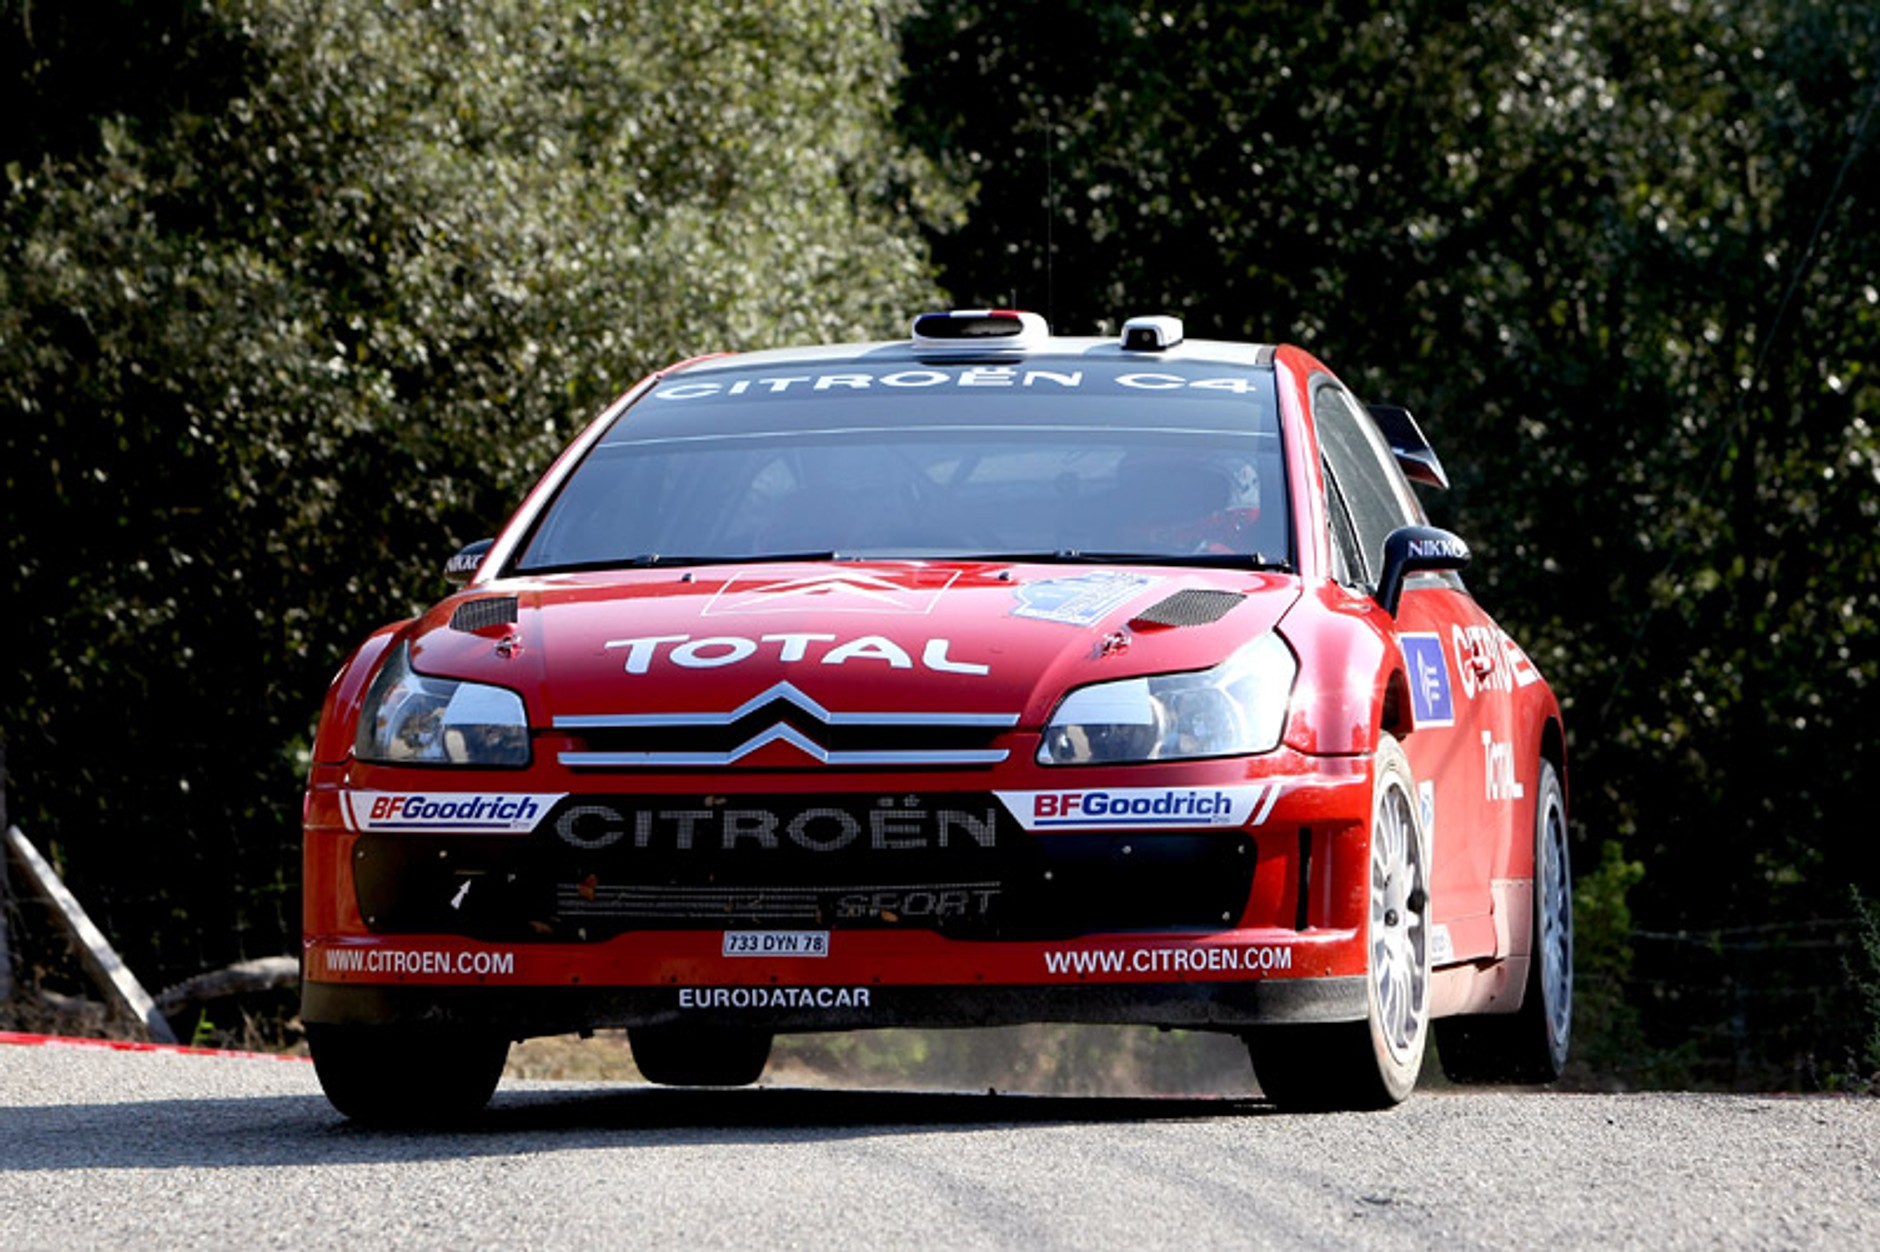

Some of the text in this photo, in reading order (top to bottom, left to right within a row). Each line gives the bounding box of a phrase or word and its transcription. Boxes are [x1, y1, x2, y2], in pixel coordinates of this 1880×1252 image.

[655, 366, 1257, 400] CITROËN C4
[604, 634, 989, 675] TOTAL
[370, 796, 539, 820] BFGoodrich
[1033, 791, 1232, 817] BFGoodrich
[554, 794, 997, 852] CITROËN
[836, 890, 1002, 918] SPORT
[729, 934, 823, 951] 733 DYN 78
[326, 949, 514, 974] WWW.CITROEN.COM
[1044, 946, 1292, 974] WWW.CITROEN.COM
[679, 987, 870, 1008] EURODATACAR
